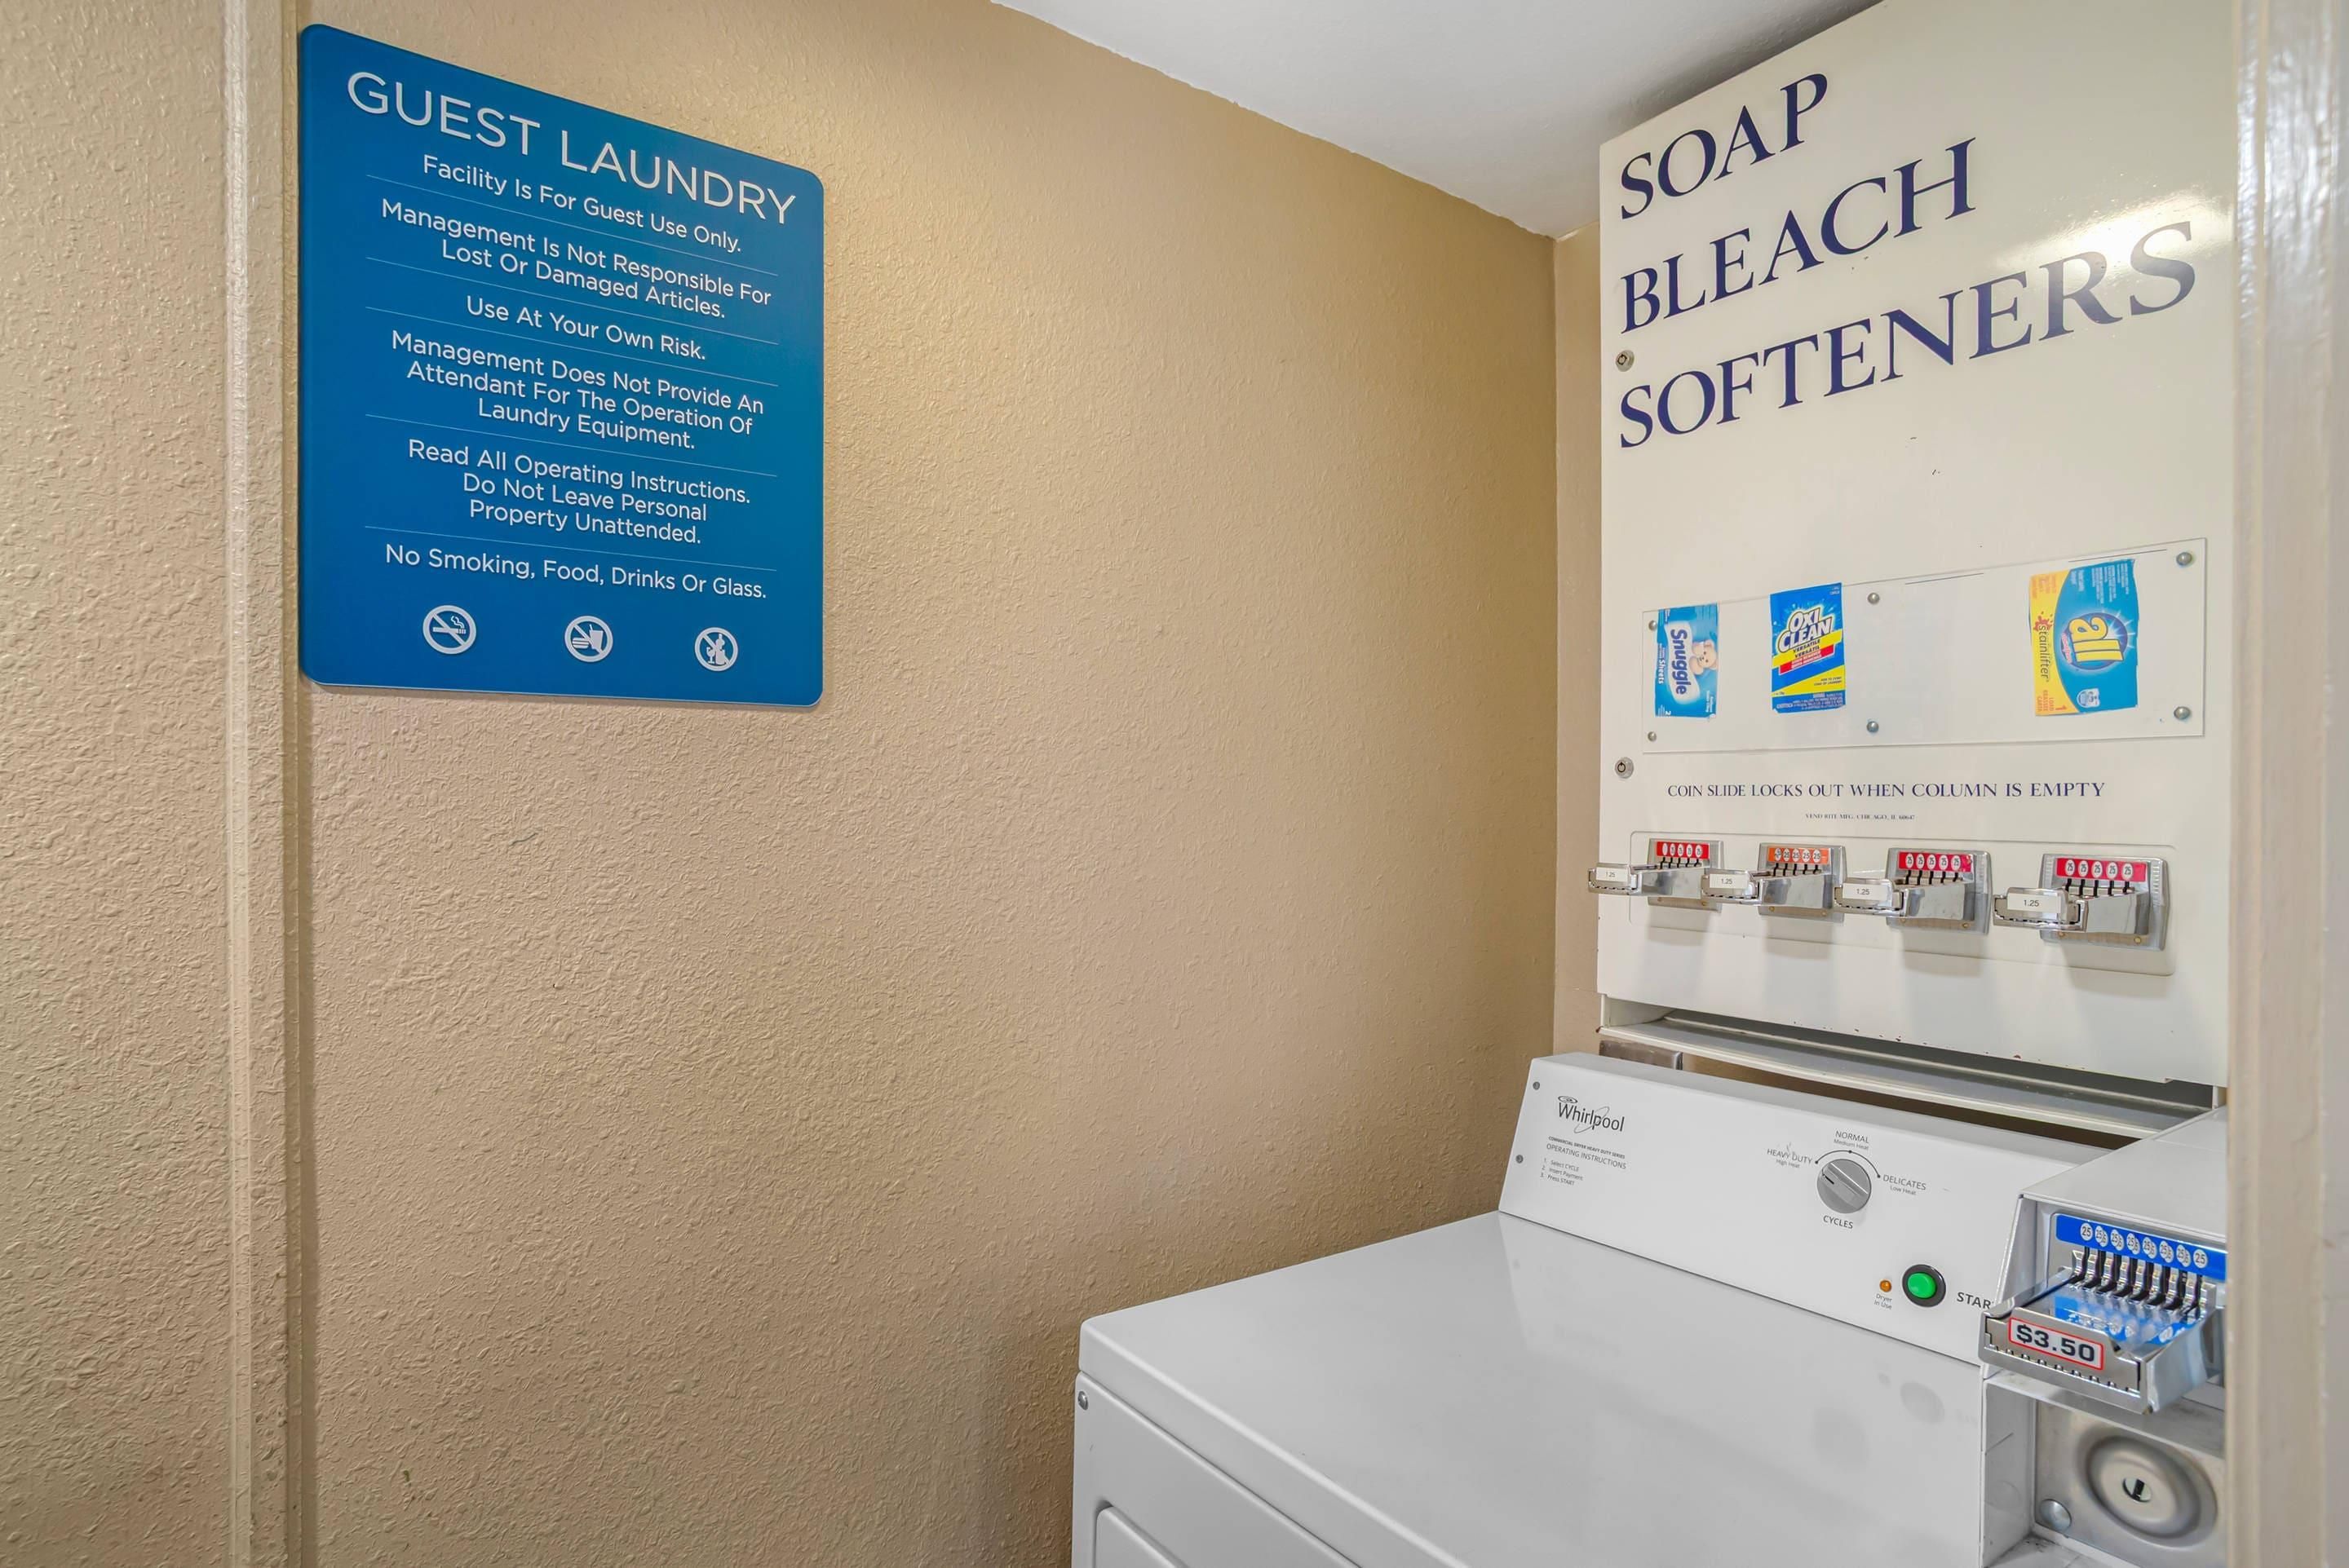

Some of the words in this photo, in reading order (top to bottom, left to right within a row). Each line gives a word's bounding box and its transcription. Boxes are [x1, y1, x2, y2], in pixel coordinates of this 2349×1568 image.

[347, 72, 541, 156] GUEST
[561, 130, 797, 224] LAUNDRY
[1620, 72, 1829, 221] SOAP
[424, 154, 507, 196] Facility
[515, 179, 532, 200] Is
[540, 185, 577, 210] For
[583, 197, 644, 227] Guest
[651, 213, 688, 238] Use
[693, 225, 741, 254] Only.
[383, 198, 536, 253] Management
[544, 237, 560, 258] Is
[568, 243, 606, 268] Not
[613, 254, 734, 297] Responsible
[740, 282, 772, 305] For
[1620, 137, 1976, 334] BLEACH
[443, 239, 492, 267] Lost
[500, 253, 529, 275] Or
[536, 260, 638, 299] Damaged
[645, 285, 725, 318] Articles.
[467, 295, 509, 321] Use
[516, 307, 542, 328] At
[549, 312, 599, 340] Your
[605, 324, 654, 351] Own
[661, 337, 706, 361] Risk.
[1620, 220, 2196, 448] SOFTENERS
[392, 329, 544, 376] Management
[552, 360, 606, 386] Does
[613, 371, 651, 395] Not
[657, 378, 732, 409] Provide
[737, 394, 763, 414] An
[407, 360, 526, 398] Attendant
[533, 382, 570, 404] For
[577, 389, 617, 413] The
[623, 398, 723, 431] Operation
[729, 416, 753, 435] Of
[479, 397, 570, 433] Laundry
[578, 413, 695, 449] Equipment.
[409, 439, 469, 466] Read
[477, 449, 506, 470] All
[515, 455, 623, 490] Operating
[631, 470, 750, 504] Instructions.
[463, 472, 496, 494] Do
[504, 478, 544, 501] Not
[552, 484, 614, 510] Leave
[622, 493, 706, 521] Personal
[471, 499, 568, 532] Property
[576, 512, 701, 544] Unattended.
[387, 544, 420, 565] No
[428, 548, 535, 579] Smoking,
[544, 559, 604, 585] Food,
[612, 567, 675, 590] Drinks
[682, 574, 706, 593] Or
[713, 577, 766, 598] Glass.
[1778, 616, 1833, 653] CLEAN
[1789, 607, 1820, 633] OXI
[2069, 616, 2124, 662] all
[1658, 658, 1666, 684] Sheets
[1670, 629, 1692, 695] Snuggle
[2038, 625, 2050, 679] stainlifter
[1667, 784, 1704, 797] COIN
[1707, 784, 1746, 797] SLIDE
[1750, 784, 1803, 797] LOCKS
[1808, 784, 1844, 797] OUT
[1850, 784, 1905, 797] WHEN
[1911, 783, 1997, 797] COLUMN
[2006, 783, 2022, 797] IS
[2030, 782, 2106, 797] EMPTY
[2023, 899, 2040, 908] 1.25
[1559, 1102, 1625, 1132] Whirlpool
[1835, 1130, 1869, 1144] NORMAL
[1546, 1143, 1580, 1158] OPERATING
[1581, 1151, 1626, 1169] INSTRUCTIONS
[1767, 1148, 1791, 1159] HEAVY
[1792, 1151, 1812, 1164] DUTY
[1856, 1142, 1869, 1151] Heat
[1563, 1171, 1583, 1181] Payment
[1883, 1174, 1927, 1190] DELICATES
[1823, 1215, 1854, 1230] CYCLES
[2081, 1226, 2091, 1237] 25
[2196, 1253, 2205, 1264] 25
[1876, 1293, 1892, 1302] Dryer
[1881, 1301, 1892, 1310] Use
[1956, 1292, 1995, 1310] STAR
[2016, 1323, 2095, 1363] $3.50
